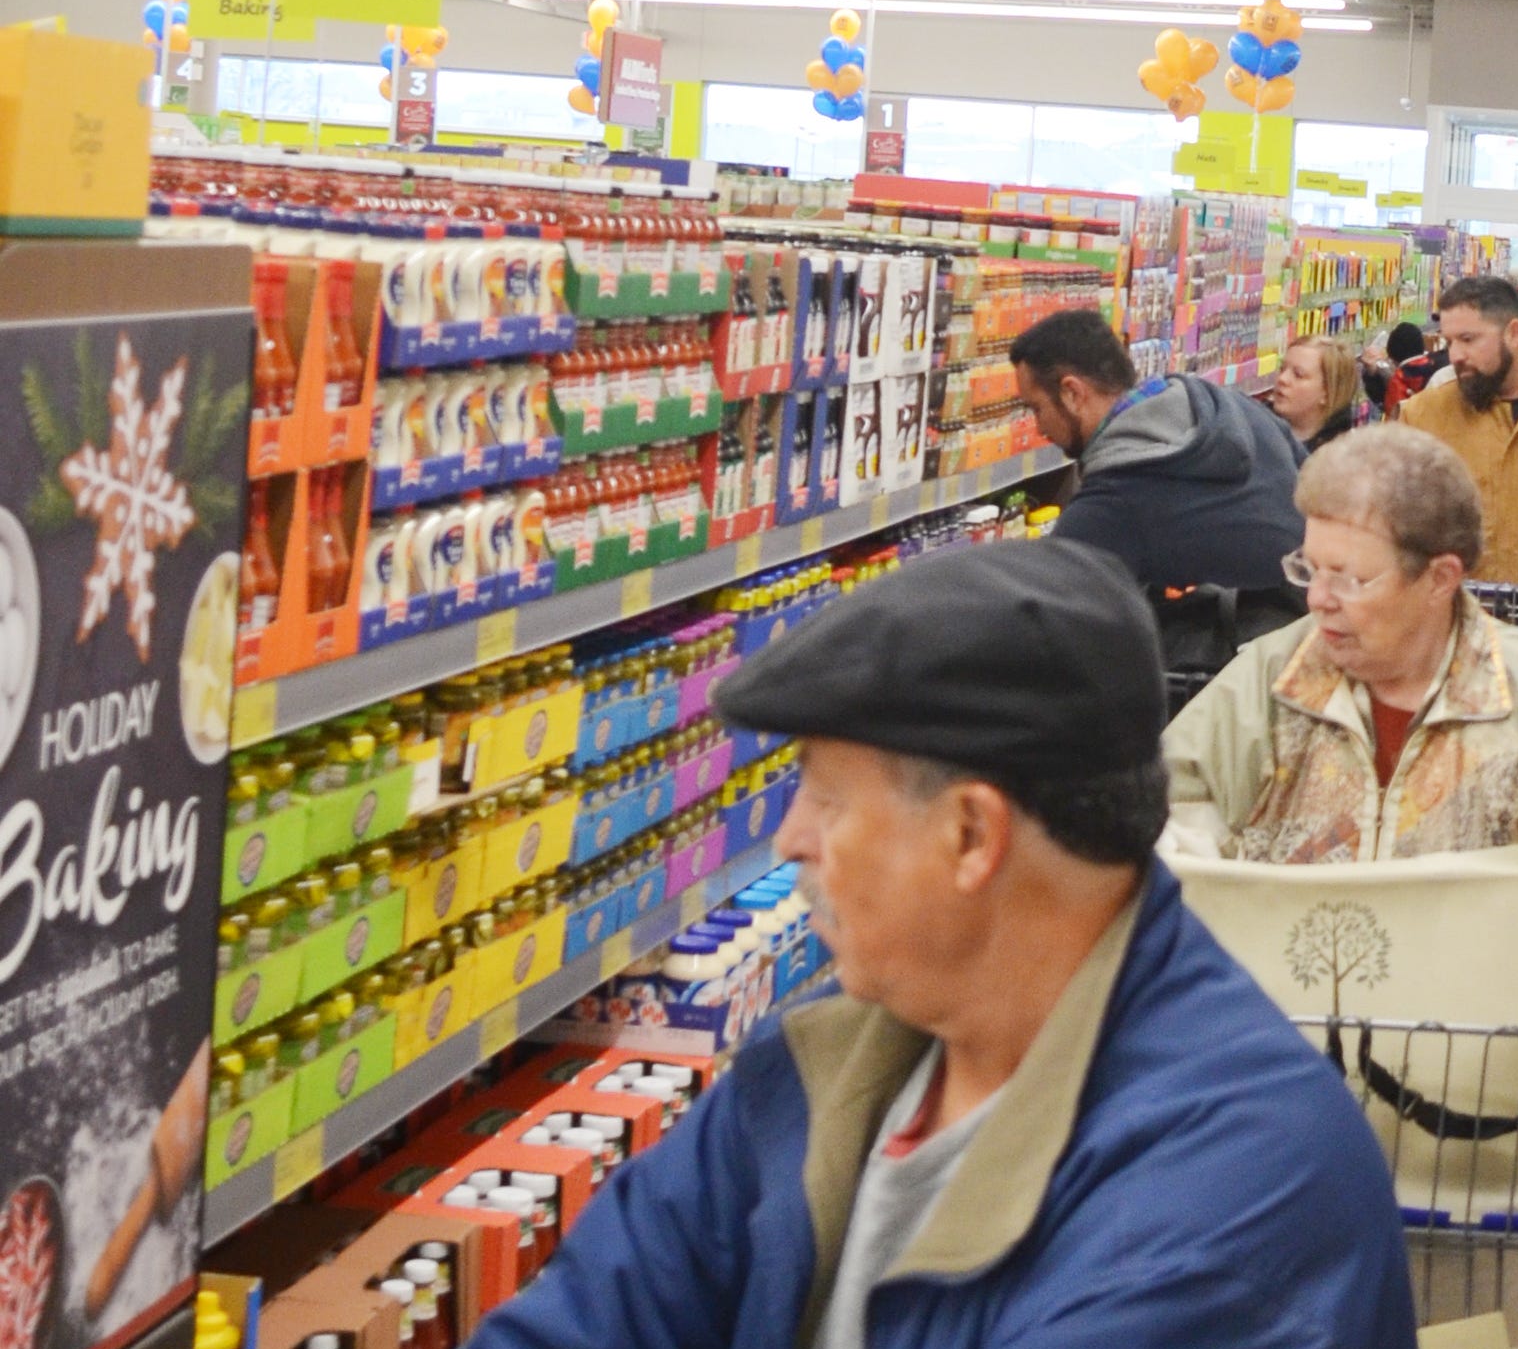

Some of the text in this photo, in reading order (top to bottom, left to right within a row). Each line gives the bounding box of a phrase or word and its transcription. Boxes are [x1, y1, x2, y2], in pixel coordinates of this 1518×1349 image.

[408, 71, 428, 97] 3
[881, 103, 894, 128] 1
[40, 680, 161, 771] HOLIDAY
[0, 764, 201, 984] Baking
[26, 982, 54, 1021] THE
[122, 940, 144, 973] TO
[143, 923, 180, 965] BAKE
[86, 980, 145, 1033] HOLIDAY
